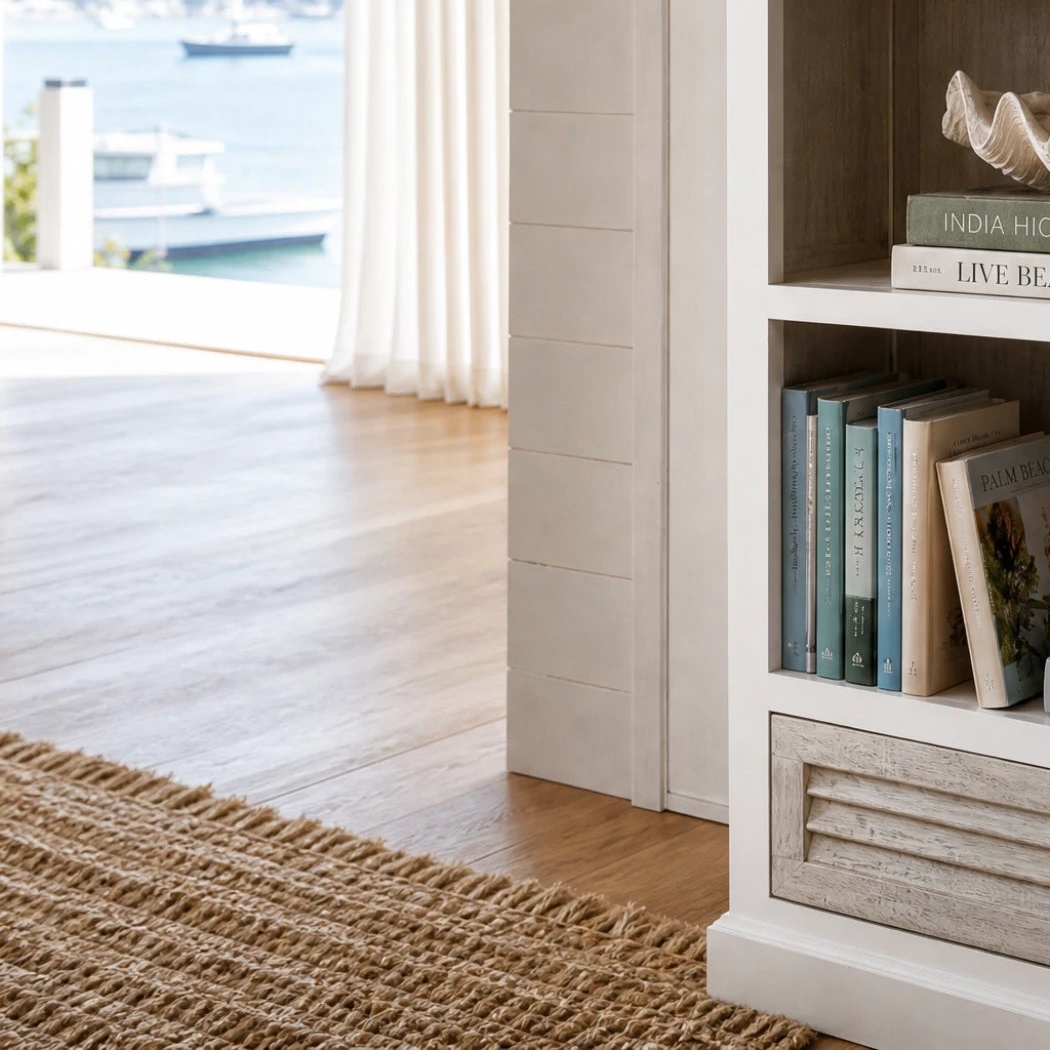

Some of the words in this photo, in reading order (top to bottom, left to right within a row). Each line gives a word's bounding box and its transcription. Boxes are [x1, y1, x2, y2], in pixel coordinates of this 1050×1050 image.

[943, 211, 1005, 235] INDIA
[956, 260, 1009, 286] LIVE
[981, 466, 1018, 492] PALM
